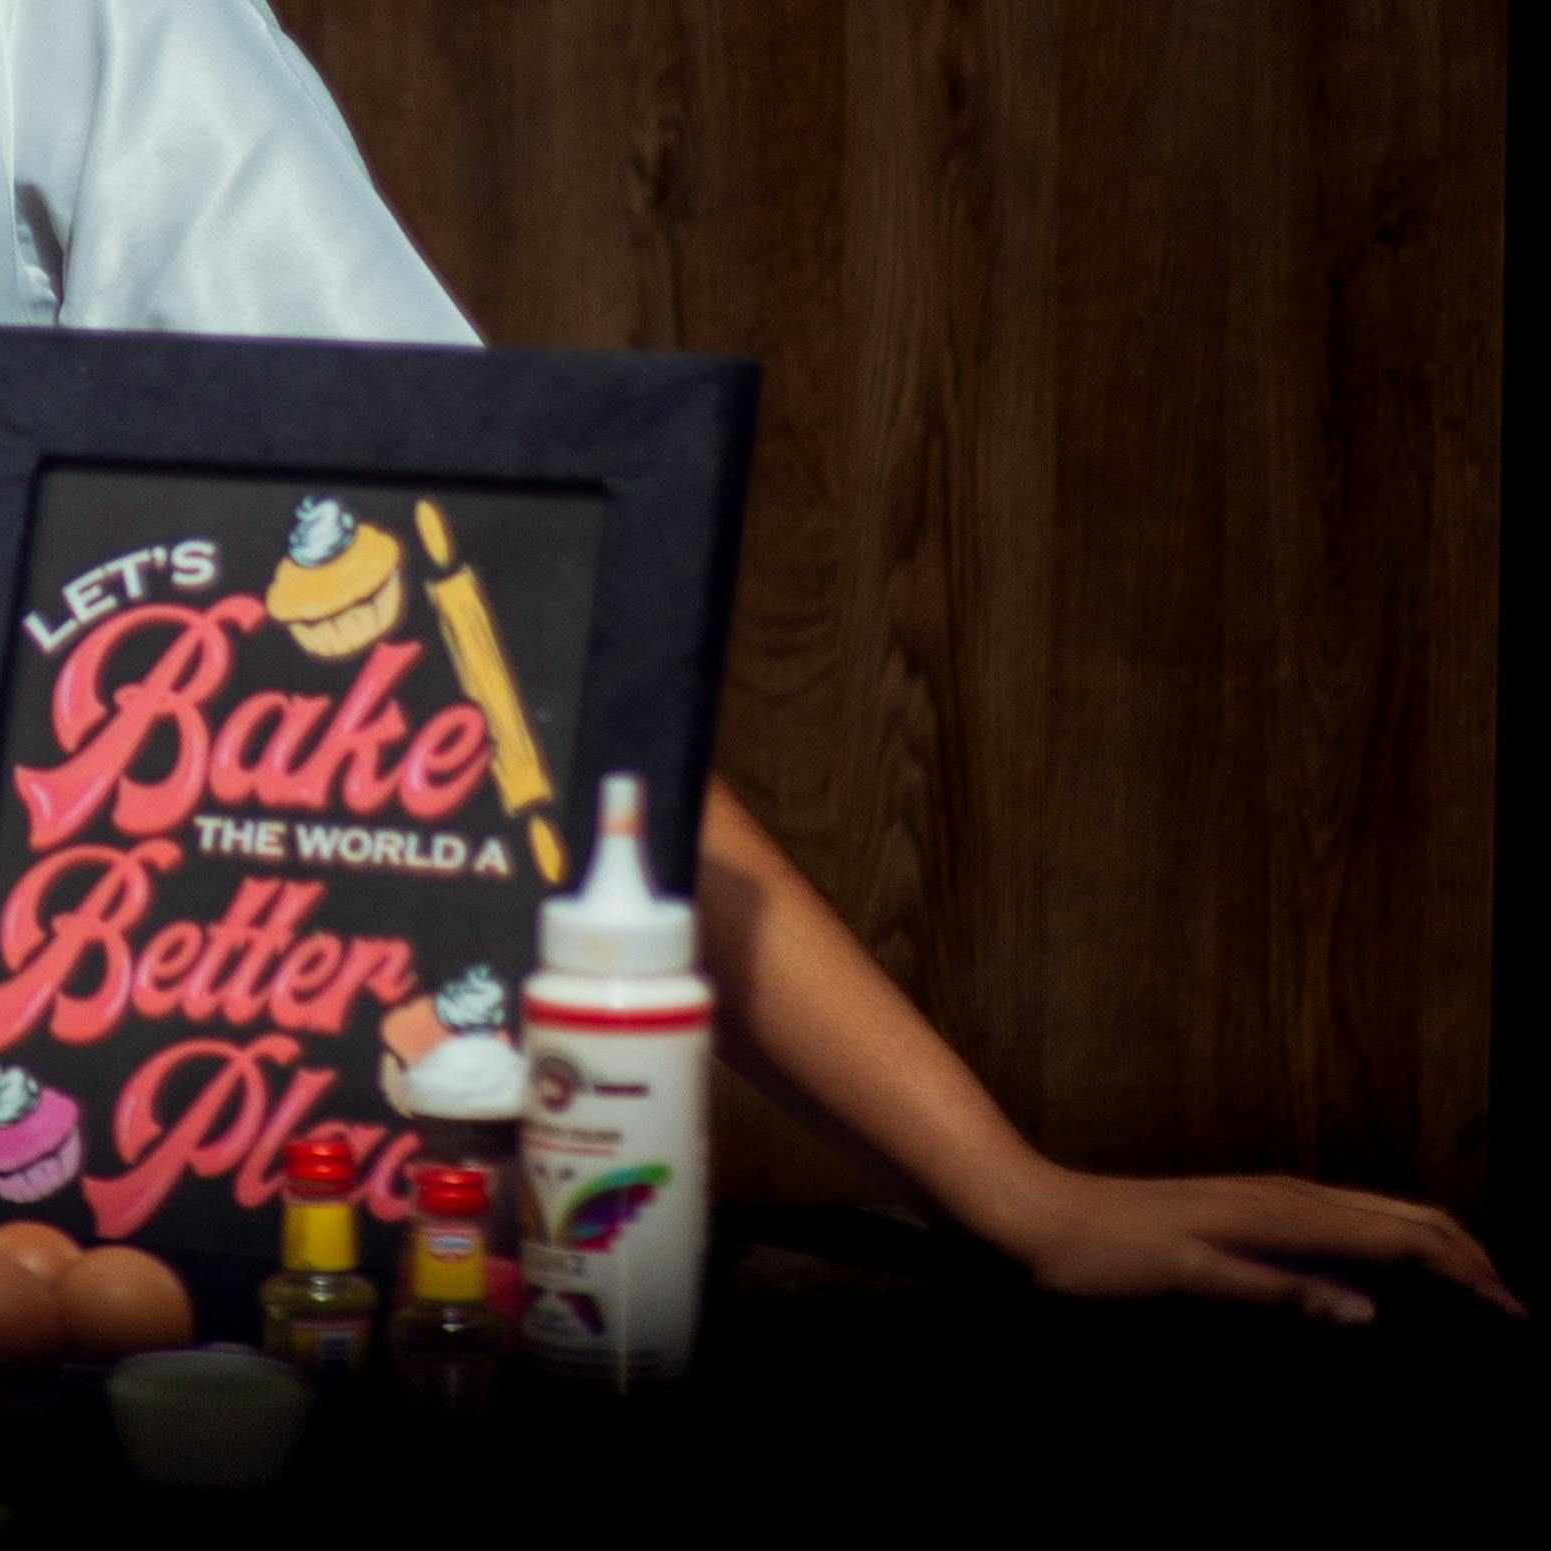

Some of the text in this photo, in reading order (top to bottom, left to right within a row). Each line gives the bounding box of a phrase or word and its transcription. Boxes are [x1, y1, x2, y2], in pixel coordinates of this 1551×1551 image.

[22, 539, 219, 653] LET'S
[13, 593, 494, 849] Bake
[194, 815, 511, 875] THE WORLD A
